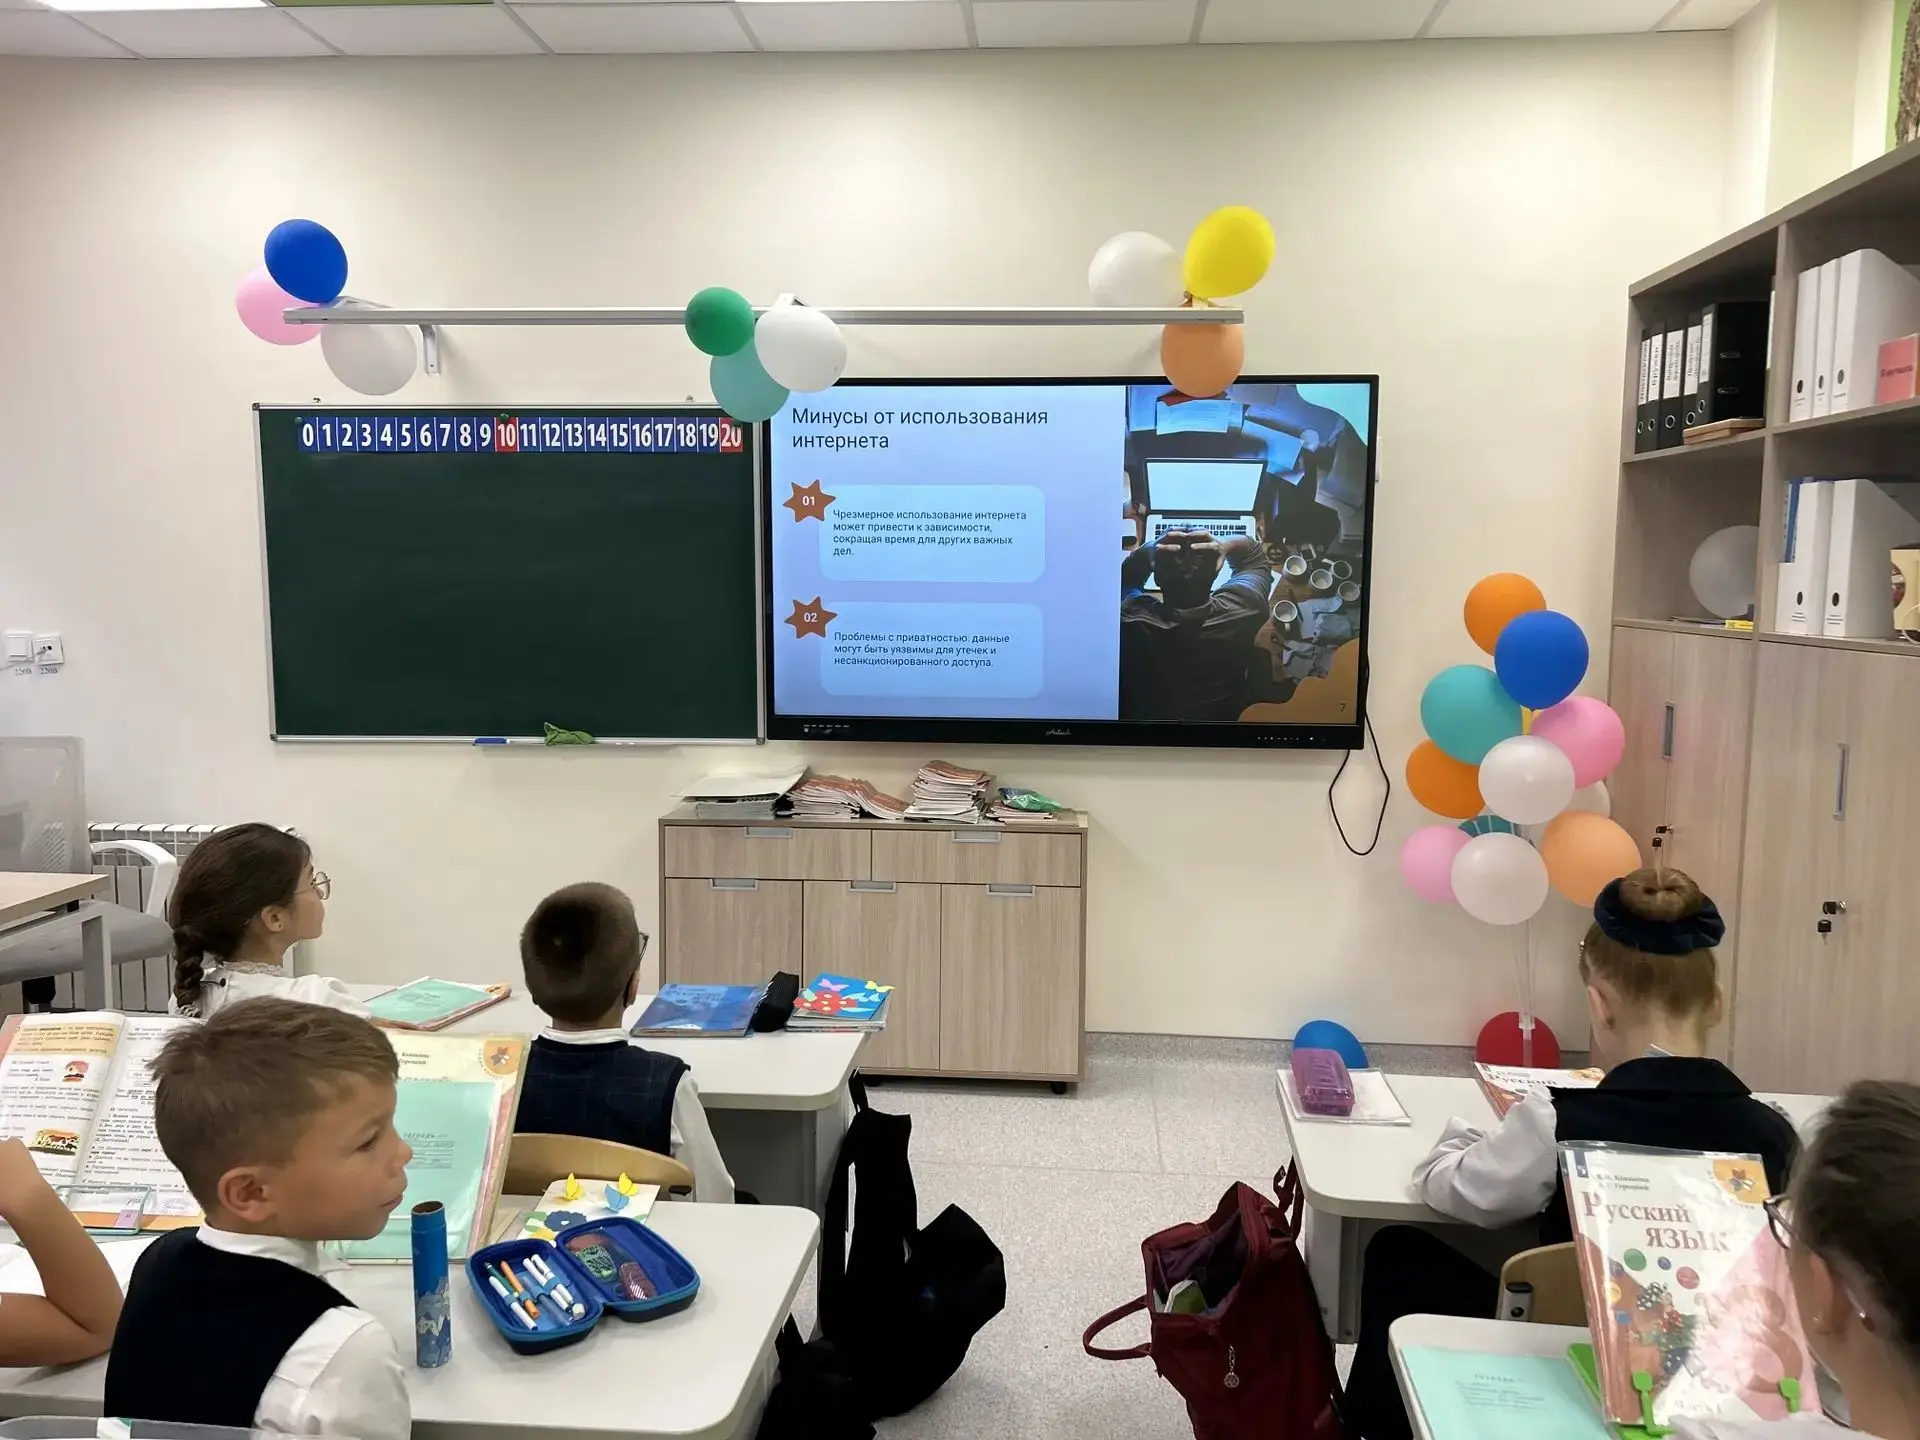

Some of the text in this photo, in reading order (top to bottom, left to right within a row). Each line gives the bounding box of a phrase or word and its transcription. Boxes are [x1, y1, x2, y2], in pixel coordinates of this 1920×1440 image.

[792, 407, 1049, 428] Минусы от использования
[302, 423, 742, 447] 0 1 2 3 4 5 6 7 8 9 10 11 12 13 14 15 16 17 18 19 20
[792, 435, 889, 452] интернета
[802, 495, 816, 506] 01
[833, 509, 1028, 521] Чрезмерное использование интернета
[833, 524, 993, 533] может привести к зависимости,
[833, 535, 1013, 546] сокращая время для других важных
[833, 547, 854, 557] дел.
[803, 612, 818, 623] 02
[834, 631, 886, 642] Проблемы
[888, 633, 894, 641] с
[971, 635, 1010, 644] данные
[834, 646, 862, 655] могут
[864, 644, 889, 654] быть
[890, 646, 934, 656] уязвимы
[935, 646, 954, 656] для
[956, 647, 988, 657] утечек
[834, 657, 950, 668] несанкционированного
[1340, 702, 1347, 713] 7
[1581, 1190, 1692, 1224] Русский
